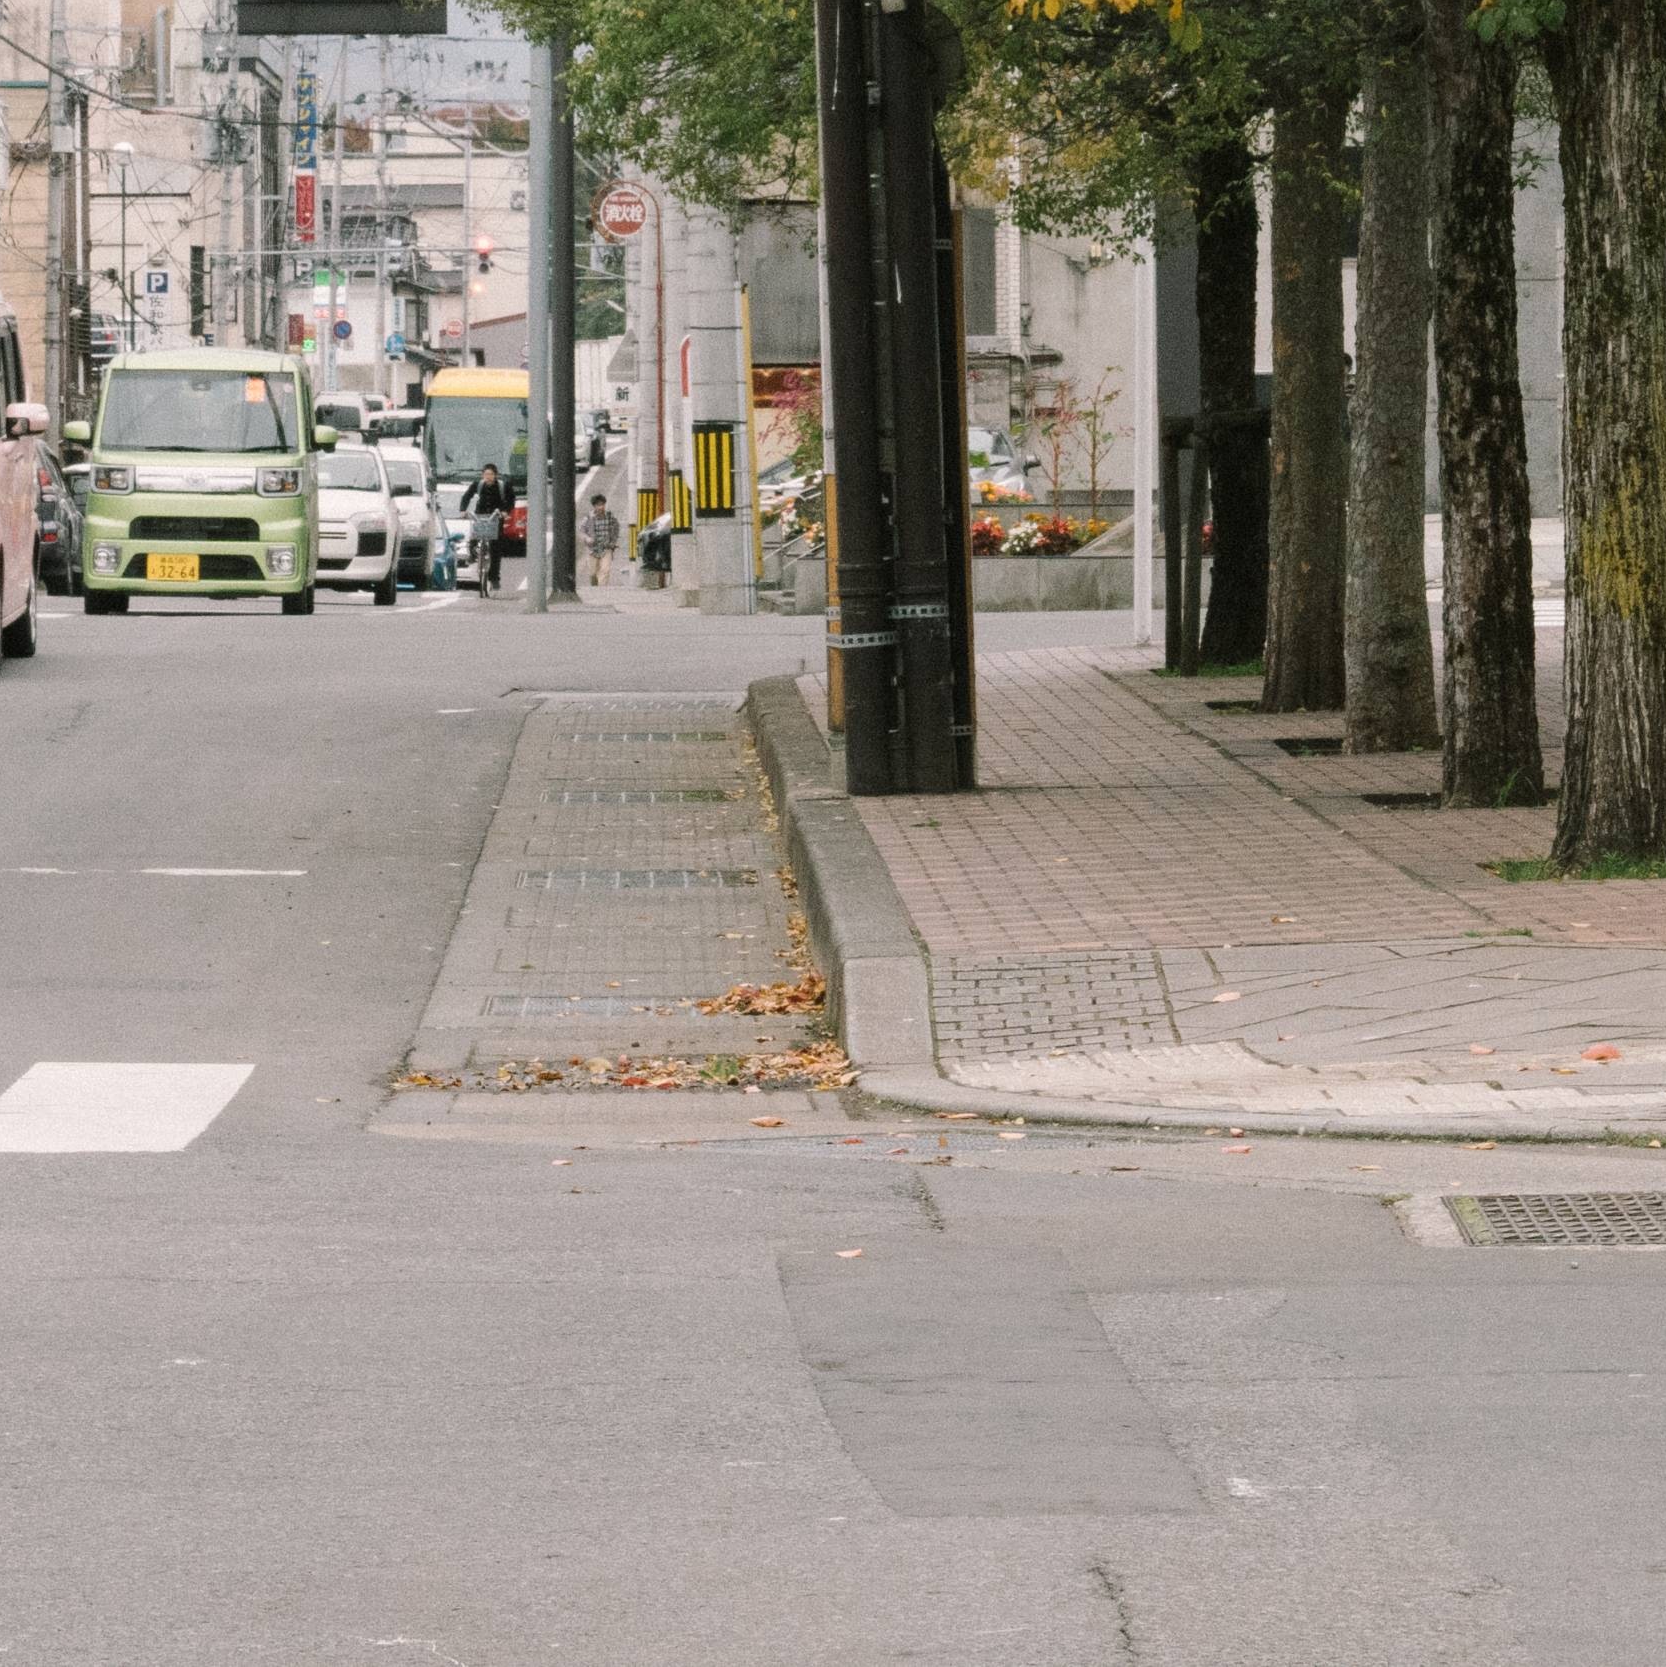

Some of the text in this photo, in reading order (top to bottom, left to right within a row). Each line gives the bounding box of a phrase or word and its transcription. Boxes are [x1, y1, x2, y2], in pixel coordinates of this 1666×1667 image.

[606, 202, 644, 222] 消火栓
[150, 274, 165, 292] P
[159, 565, 196, 579] 32-64
